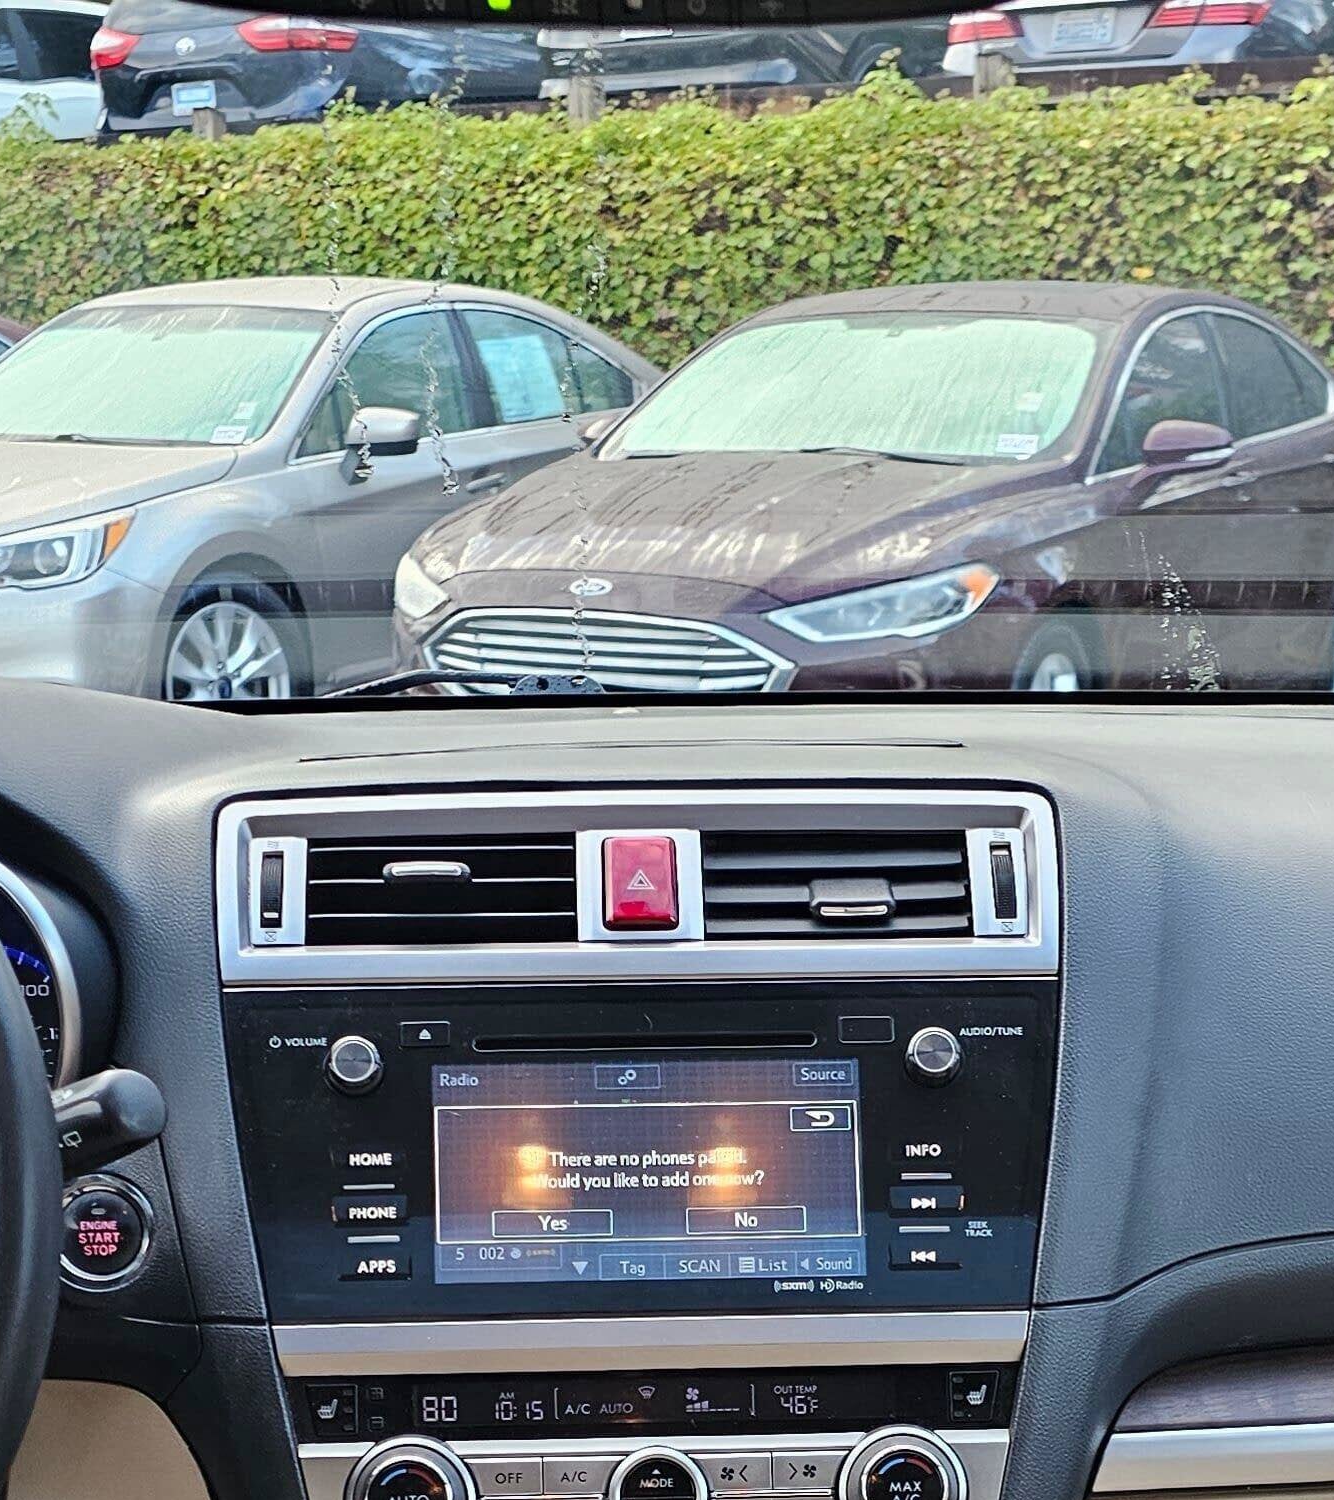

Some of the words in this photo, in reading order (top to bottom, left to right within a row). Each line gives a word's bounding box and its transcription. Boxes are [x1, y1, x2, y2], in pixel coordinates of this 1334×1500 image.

[959, 1026, 1024, 1037] AUDIO/TUNE
[284, 1037, 328, 1047] VOLUME
[439, 1071, 480, 1088] Radio
[800, 1066, 847, 1083] Source
[905, 1143, 942, 1157] INFO
[348, 1152, 393, 1167] HOME
[548, 1150, 592, 1167] There
[593, 1154, 618, 1167] are
[620, 1154, 640, 1167] no
[642, 1149, 695, 1169] phones
[583, 1175, 611, 1191] you
[613, 1172, 640, 1188] like
[642, 1173, 659, 1187] to
[661, 1171, 690, 1187] add
[348, 1206, 398, 1220] PHONE
[734, 1211, 758, 1228] No
[79, 1220, 118, 1231] ENGINE
[537, 1214, 568, 1231] Yes
[78, 1231, 121, 1244] START
[964, 1228, 993, 1238] TRACK
[83, 1244, 118, 1256] STOP
[454, 1247, 465, 1261] 5
[479, 1246, 505, 1260] 002
[356, 1259, 397, 1274] APPS
[619, 1260, 646, 1276] Tag
[678, 1258, 721, 1274] SCAN
[758, 1257, 788, 1272] List
[816, 1256, 852, 1271] Sound
[835, 1280, 864, 1290] Radio
[499, 1391, 515, 1400] AM
[773, 1385, 793, 1394] OUT
[795, 1385, 818, 1394] TEMP
[422, 1396, 458, 1422] 80
[495, 1400, 545, 1421] 10:15
[565, 1403, 591, 1415] A/C
[599, 1403, 634, 1415] AUTO
[494, 1472, 524, 1484] OFF
[560, 1471, 588, 1483] A/C
[639, 1477, 674, 1489] MODE
[889, 1481, 923, 1493] MAX
